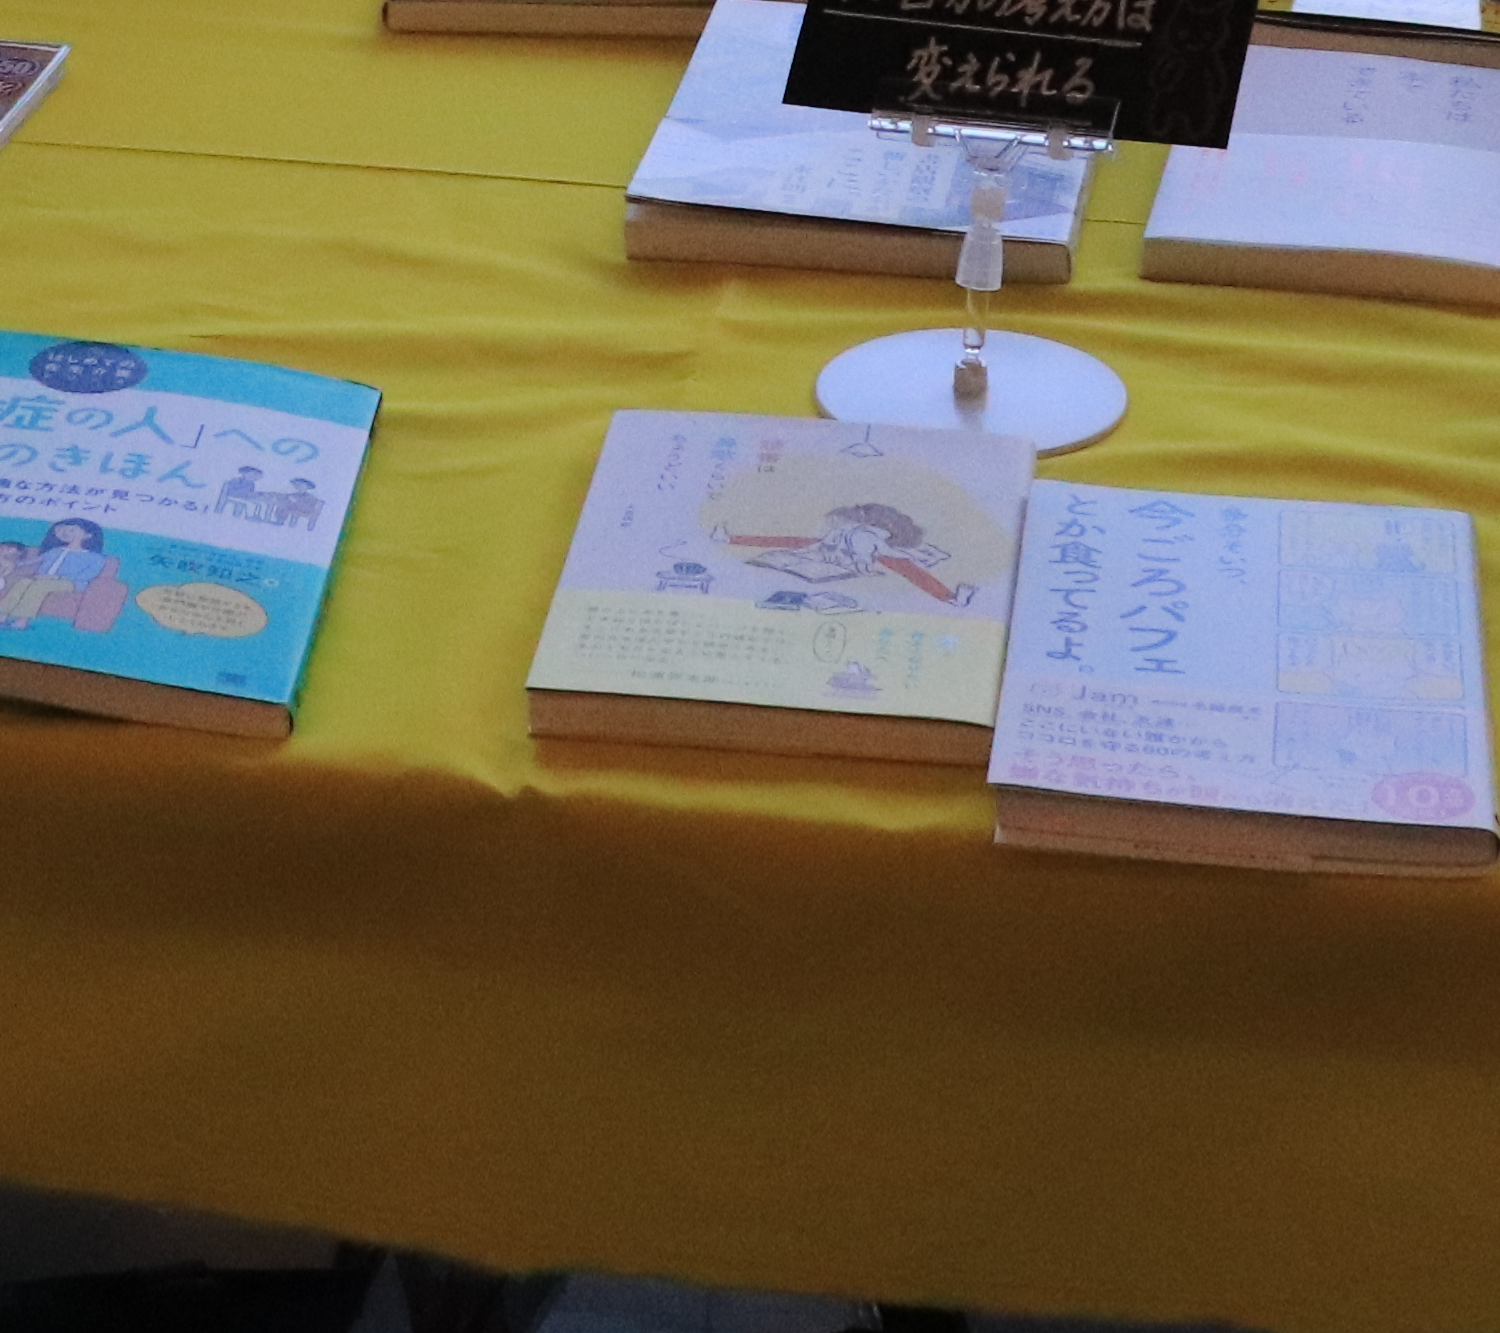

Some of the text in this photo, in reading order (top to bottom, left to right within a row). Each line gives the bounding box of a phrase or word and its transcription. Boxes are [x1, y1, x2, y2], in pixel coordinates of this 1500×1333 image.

[905, 36, 1097, 109] 変えられる
[1044, 493, 1107, 675] とか食ってるよ。
[1118, 499, 1196, 675] 今ごろパフェ
[1073, 685, 1139, 707] Jam
